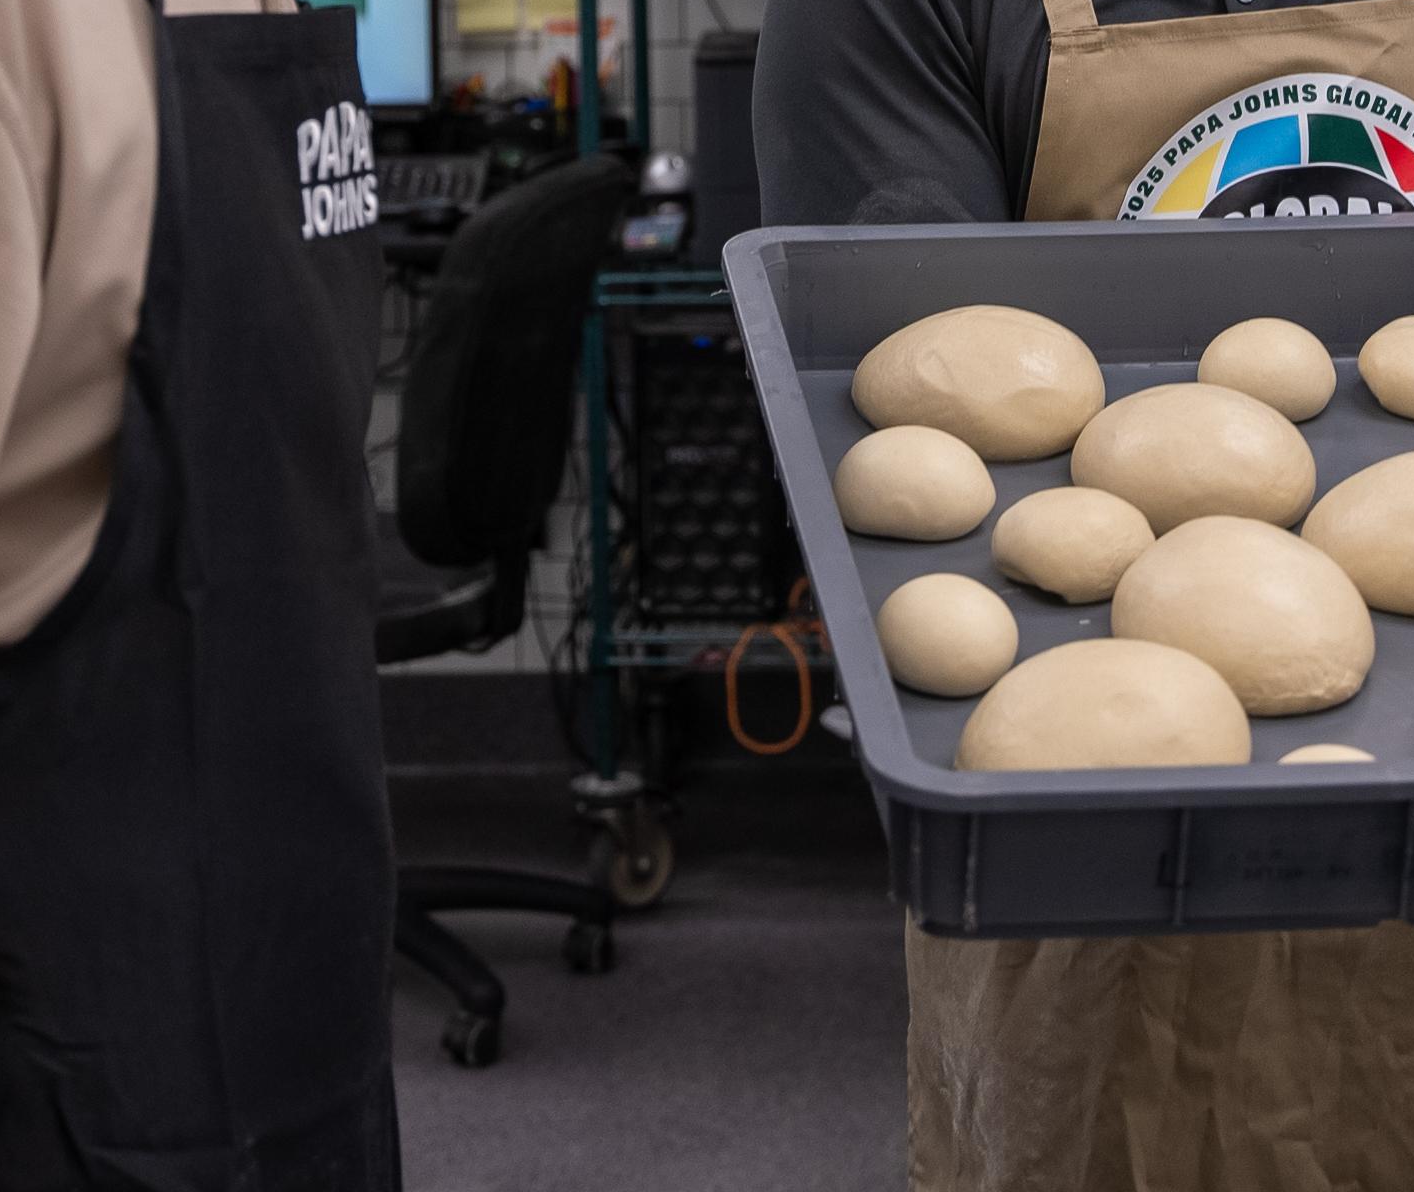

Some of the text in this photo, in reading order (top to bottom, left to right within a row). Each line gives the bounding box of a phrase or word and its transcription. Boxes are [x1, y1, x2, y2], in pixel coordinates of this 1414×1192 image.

[297, 100, 375, 184] PAPA
[1121, 165, 1164, 221] 2025
[1163, 114, 1224, 166] PAPA
[1228, 84, 1318, 121] JOHNS
[1326, 84, 1413, 131] GLOBAL
[301, 173, 379, 241] JOHNS
